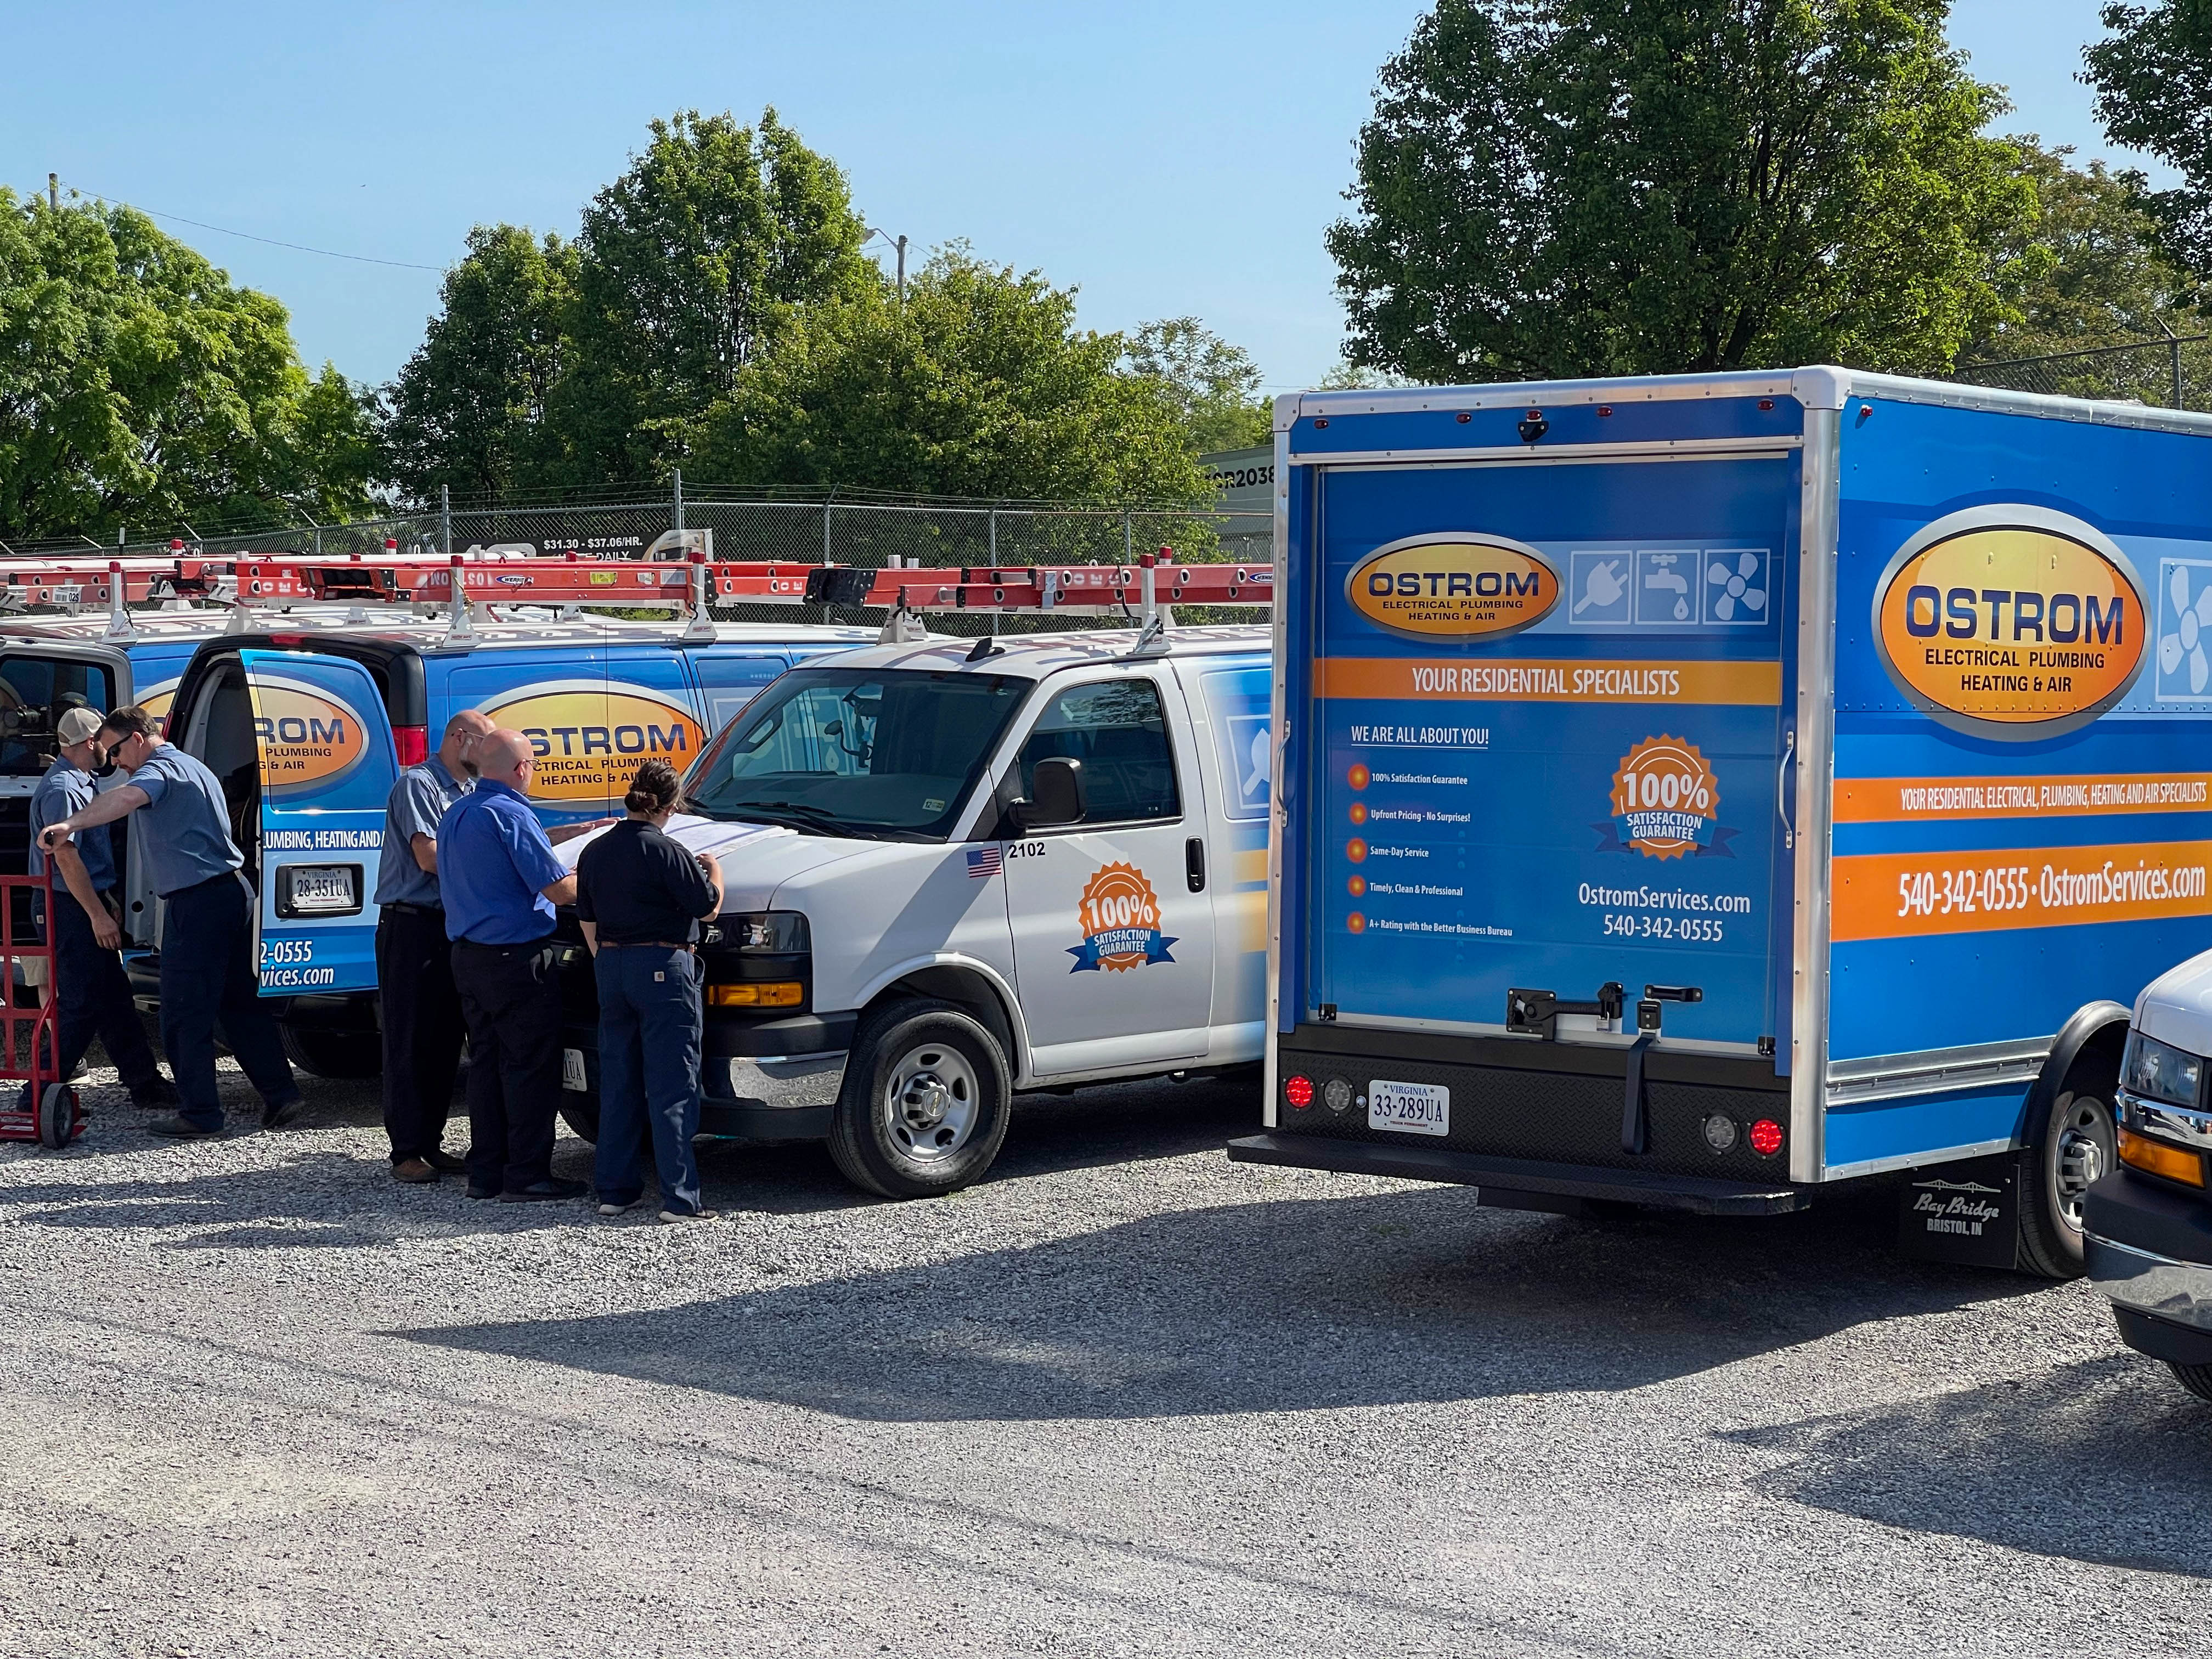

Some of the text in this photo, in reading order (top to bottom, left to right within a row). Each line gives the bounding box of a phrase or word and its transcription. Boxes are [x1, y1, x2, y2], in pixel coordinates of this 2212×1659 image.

[544, 539, 579, 550] $31.30
[588, 537, 643, 549] $37.06/HR.
[597, 551, 629, 561] DAILY
[1369, 572, 1539, 597] OSTROM
[1383, 601, 1453, 609] ELECTRICAL
[1408, 612, 1459, 620] HEATING
[1906, 585, 2124, 645] OSTROM
[1925, 648, 2105, 669] ELECTRICAL PLUMBING
[1412, 668, 1680, 695] YOUR RESIDENTIAL SPECIALISTS
[1961, 675, 2072, 692] HEATING & AIR
[521, 724, 686, 757] STROM
[1351, 726, 1489, 744] WE ARE ALL ABOUT YOU!
[266, 748, 331, 757] PLUMBING
[270, 761, 279, 769] &
[283, 761, 305, 769] AIR
[533, 760, 593, 771] CTRICAL
[541, 772, 635, 786] HEATING & AI
[1372, 773, 1468, 785] 100% Satisfaction Guarantee
[1623, 772, 1709, 809] 100%
[1901, 782, 2207, 810] YOUR RESIDENTIAL ELECTRICAL, PLUMBING, HEATING AND AIR SPECIALISTS
[1371, 809, 1397, 820] Upfront
[1398, 810, 1421, 822] Pricing
[1426, 812, 1436, 821] No
[1437, 812, 1470, 823] Surprises!
[1627, 812, 1703, 830] SATISFACTION
[314, 831, 358, 848] HEATING
[358, 831, 380, 848] AND
[1632, 825, 1695, 841] GUARANTEE
[1008, 842, 1046, 859] 2102
[1370, 846, 1429, 858] Same-Day Service
[297, 879, 351, 897] 28-351UA
[1369, 883, 1463, 896] Timely, Clean & Professional
[1898, 860, 2205, 917] 540-342-0555 OstromServices.com
[1579, 883, 1751, 913] OstromServices.com
[1087, 893, 1154, 929] 100%
[1369, 919, 1513, 936] A+ Rating with the Better Business Bureau
[1604, 915, 1723, 942] 540-342-0555
[1094, 929, 1151, 946] SATISFACTION
[1099, 941, 1146, 956] GUARANTEE
[1390, 1085, 1428, 1096] VIRGINIA
[1374, 1094, 1443, 1122] 33-289UA
[1912, 1193, 2000, 1222] Bay Bridge
[1926, 1218, 1982, 1236] BRISTOL, IN
